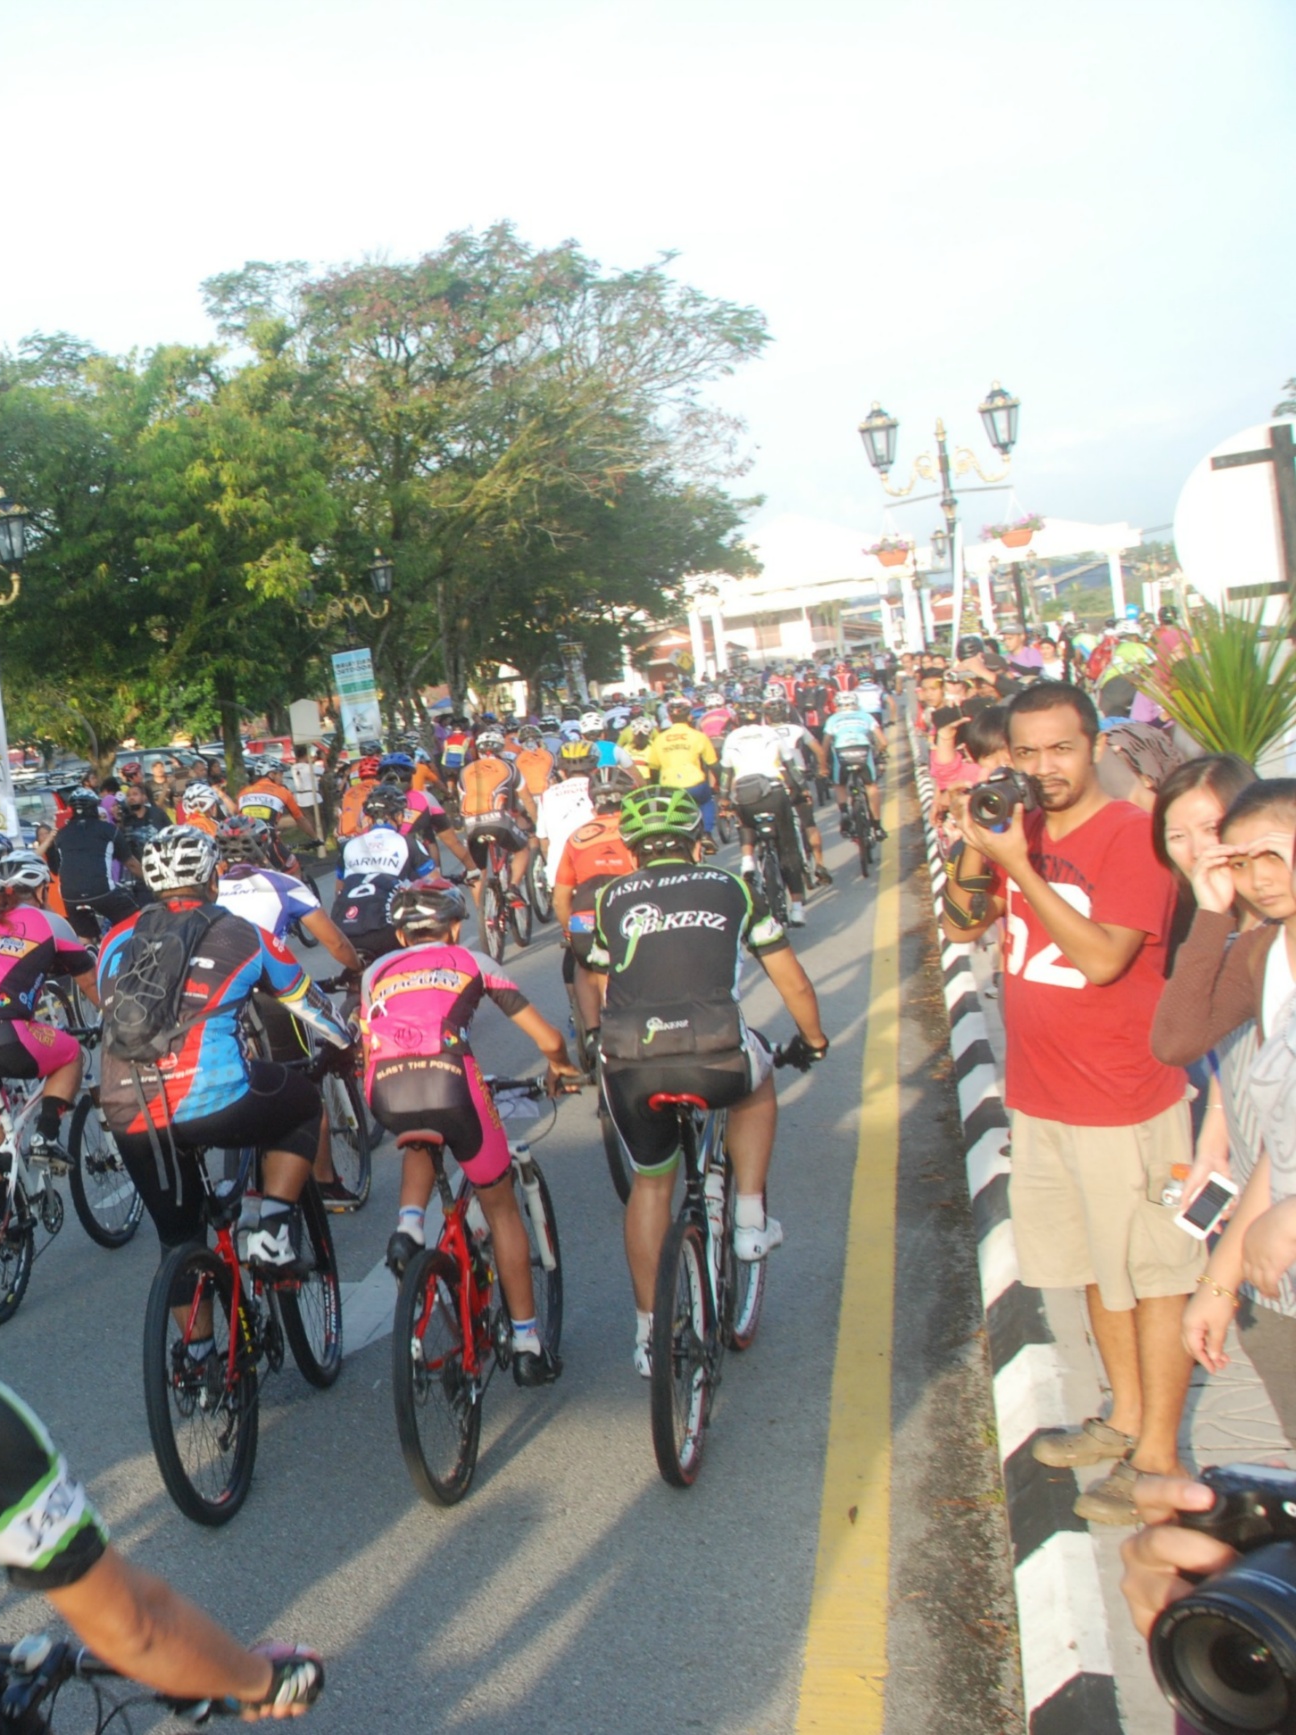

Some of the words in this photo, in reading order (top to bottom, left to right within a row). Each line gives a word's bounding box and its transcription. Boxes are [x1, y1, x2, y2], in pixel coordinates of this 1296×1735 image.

[606, 878, 654, 907] JASIN
[657, 870, 729, 888] BIKERZ
[376, 1063, 404, 1081] BLAST
[408, 1060, 428, 1070] THE
[430, 1060, 463, 1077] POWER
